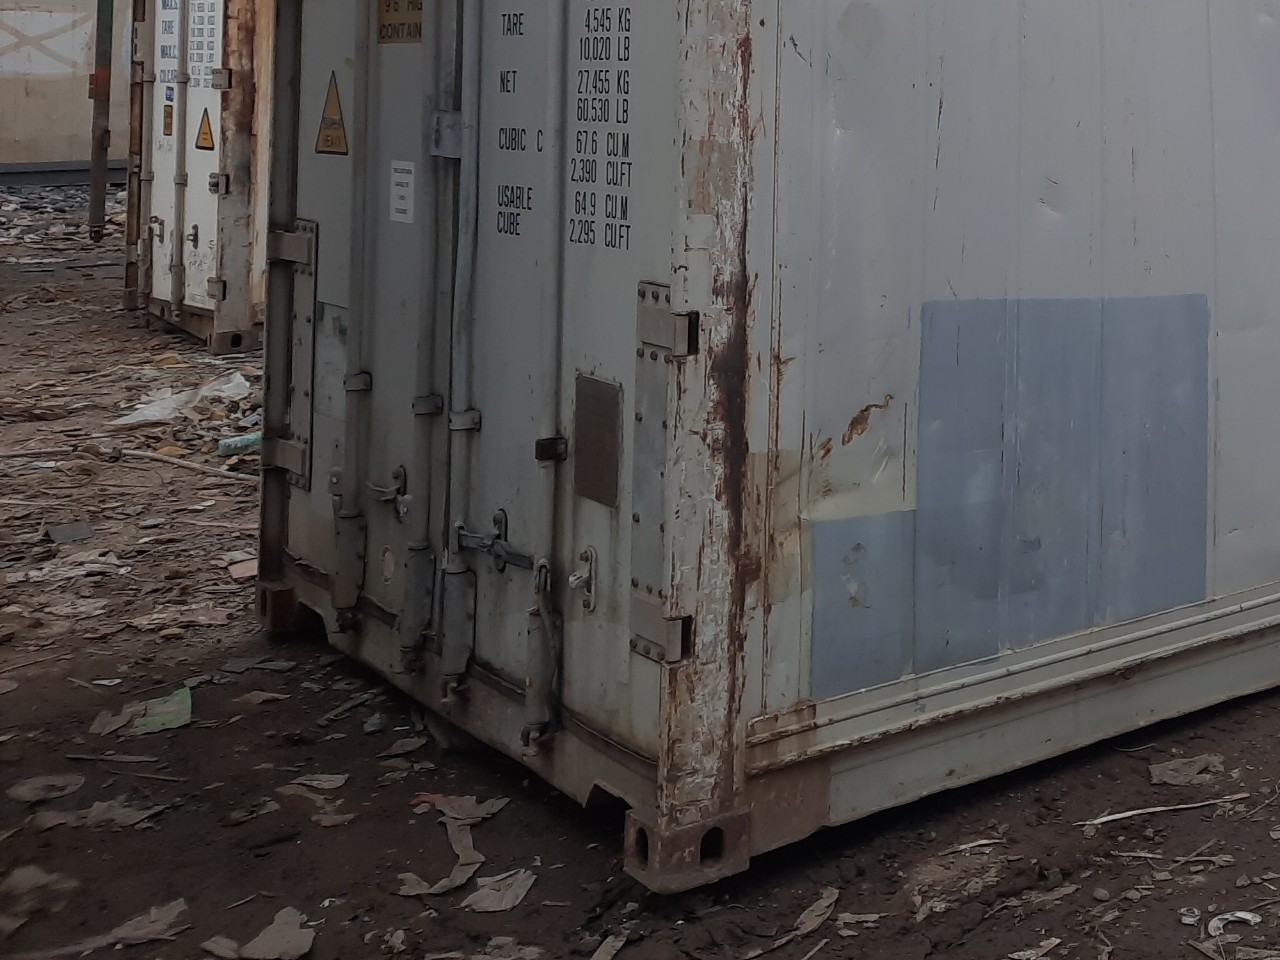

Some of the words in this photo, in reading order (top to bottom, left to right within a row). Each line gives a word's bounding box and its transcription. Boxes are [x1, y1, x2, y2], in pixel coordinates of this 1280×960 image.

[501, 13, 524, 36] TARE
[584, 7, 612, 33] 4,545
[617, 7, 631, 33] KG
[579, 36, 611, 62] 10,020
[617, 36, 630, 61] LB
[499, 70, 518, 93] NET
[577, 69, 610, 95] 27,455
[616, 70, 630, 95] KG
[576, 97, 610, 123] 60,530
[615, 98, 629, 124] LB
[498, 127, 527, 151] CUBIC
[576, 130, 598, 155] 67.6
[570, 158, 597, 183] 2,390
[497, 184, 533, 210] USABLE
[574, 191, 597, 216] 64.9
[496, 211, 521, 236] CUBE
[569, 218, 596, 244] 2,295
